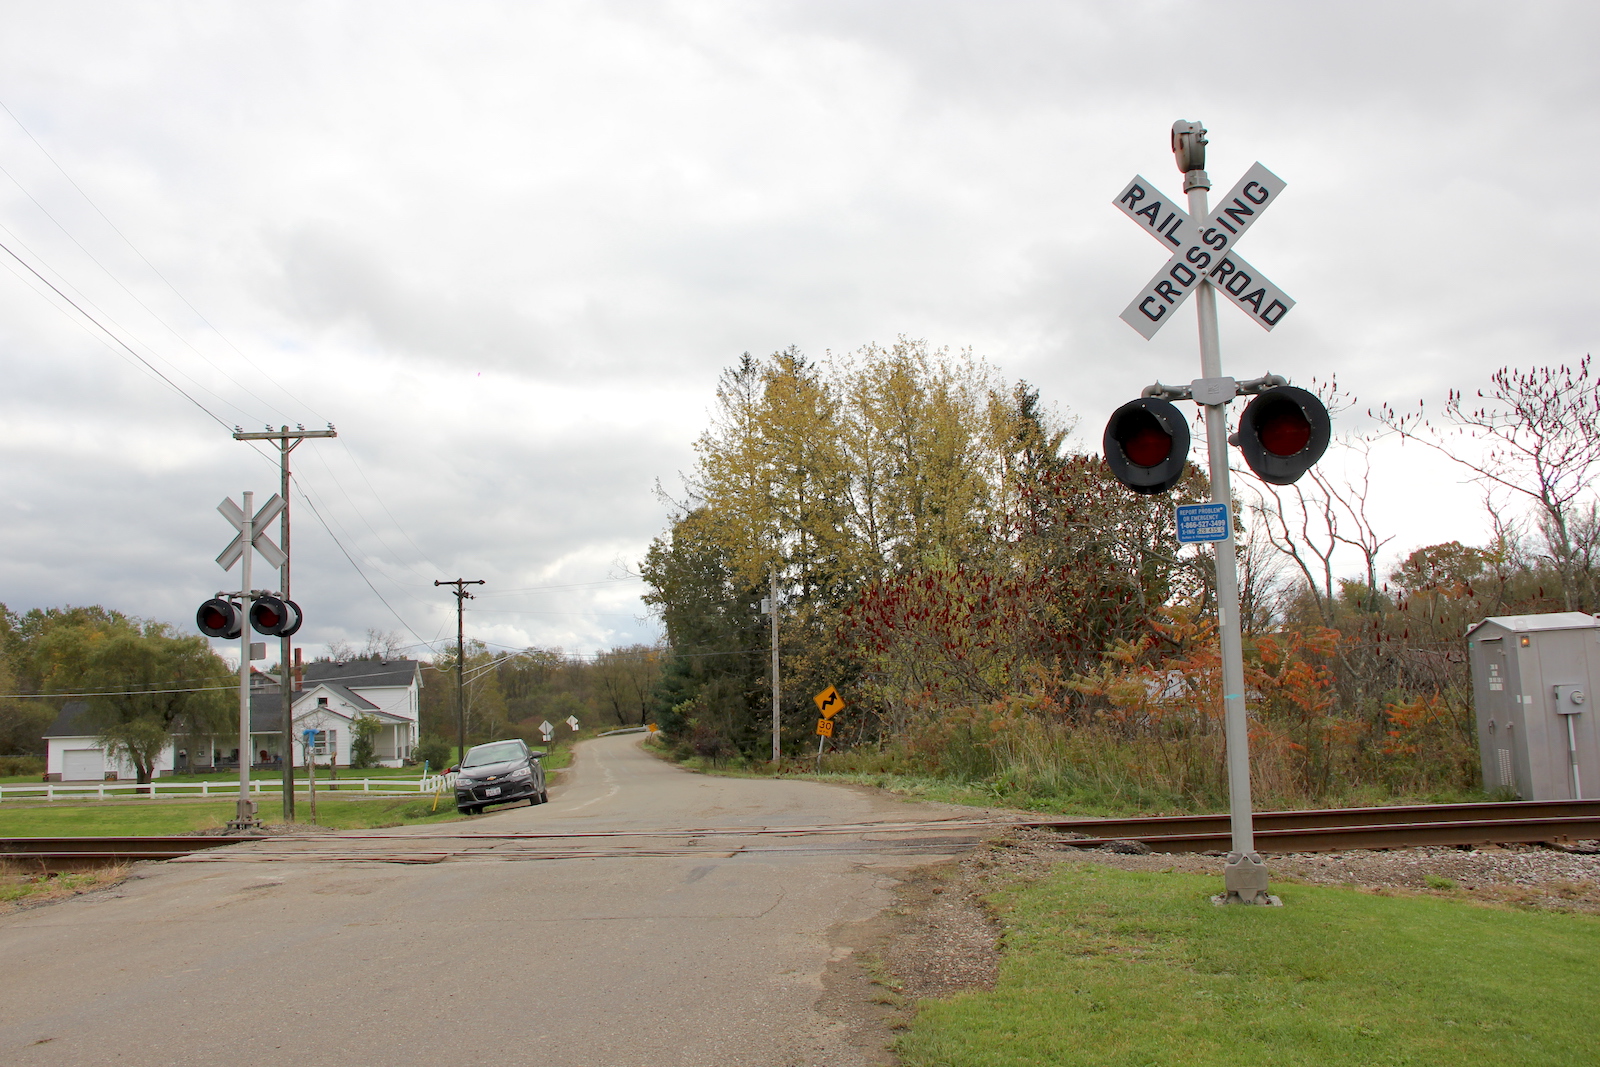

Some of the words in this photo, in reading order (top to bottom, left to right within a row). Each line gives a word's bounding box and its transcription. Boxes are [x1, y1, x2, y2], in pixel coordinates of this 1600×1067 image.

[1120, 184, 1183, 247] RAIL
[1209, 257, 1288, 326] ROAD
[1139, 181, 1269, 322] CROSSING
[1180, 520, 1225, 529] 1-866-527-3499
[819, 721, 831, 730] 30
